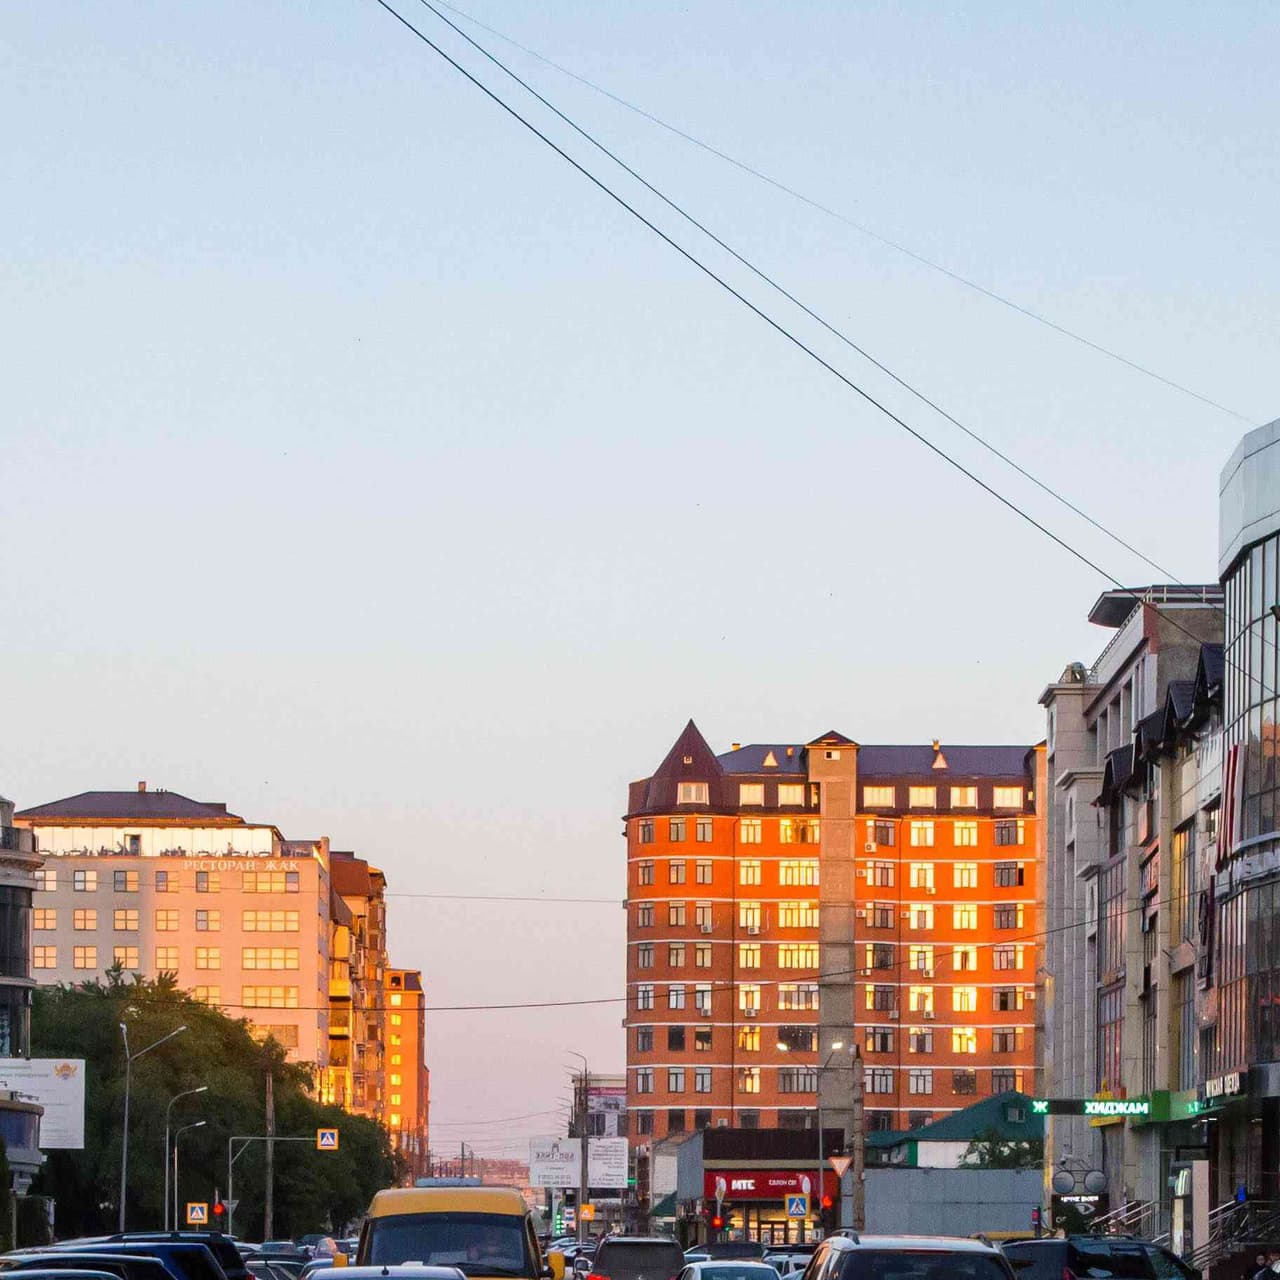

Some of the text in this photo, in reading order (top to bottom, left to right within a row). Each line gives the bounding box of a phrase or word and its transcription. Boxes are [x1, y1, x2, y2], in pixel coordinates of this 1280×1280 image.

[183, 860, 300, 871] РЕСТОРАН ЖАК
[731, 1179, 756, 1190] МТС
